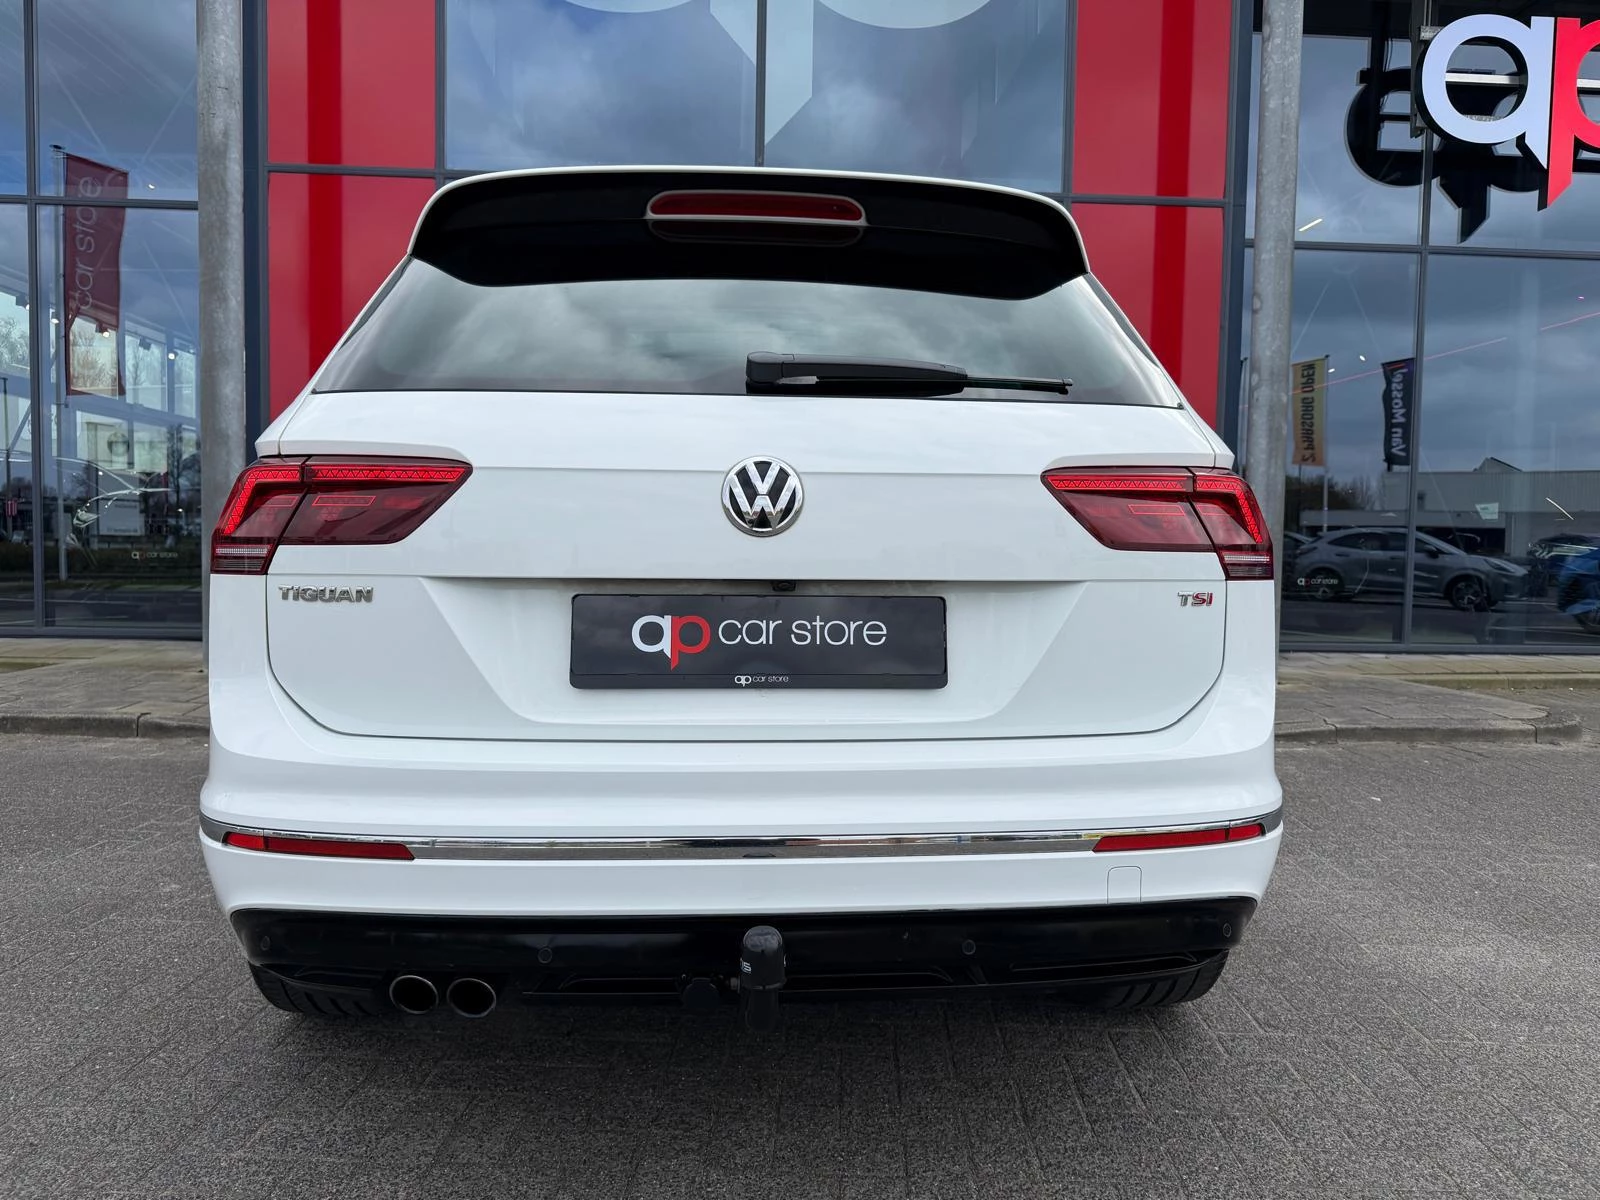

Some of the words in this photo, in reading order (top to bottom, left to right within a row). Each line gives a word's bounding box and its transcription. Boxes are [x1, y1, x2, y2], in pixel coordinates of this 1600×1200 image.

[72, 176, 100, 253] stoe
[723, 456, 803, 537] VW
[278, 585, 374, 603] TIGUAN
[1177, 591, 1213, 607] TSI
[718, 619, 782, 645] car
[791, 615, 887, 646] store
[768, 675, 789, 683] store
